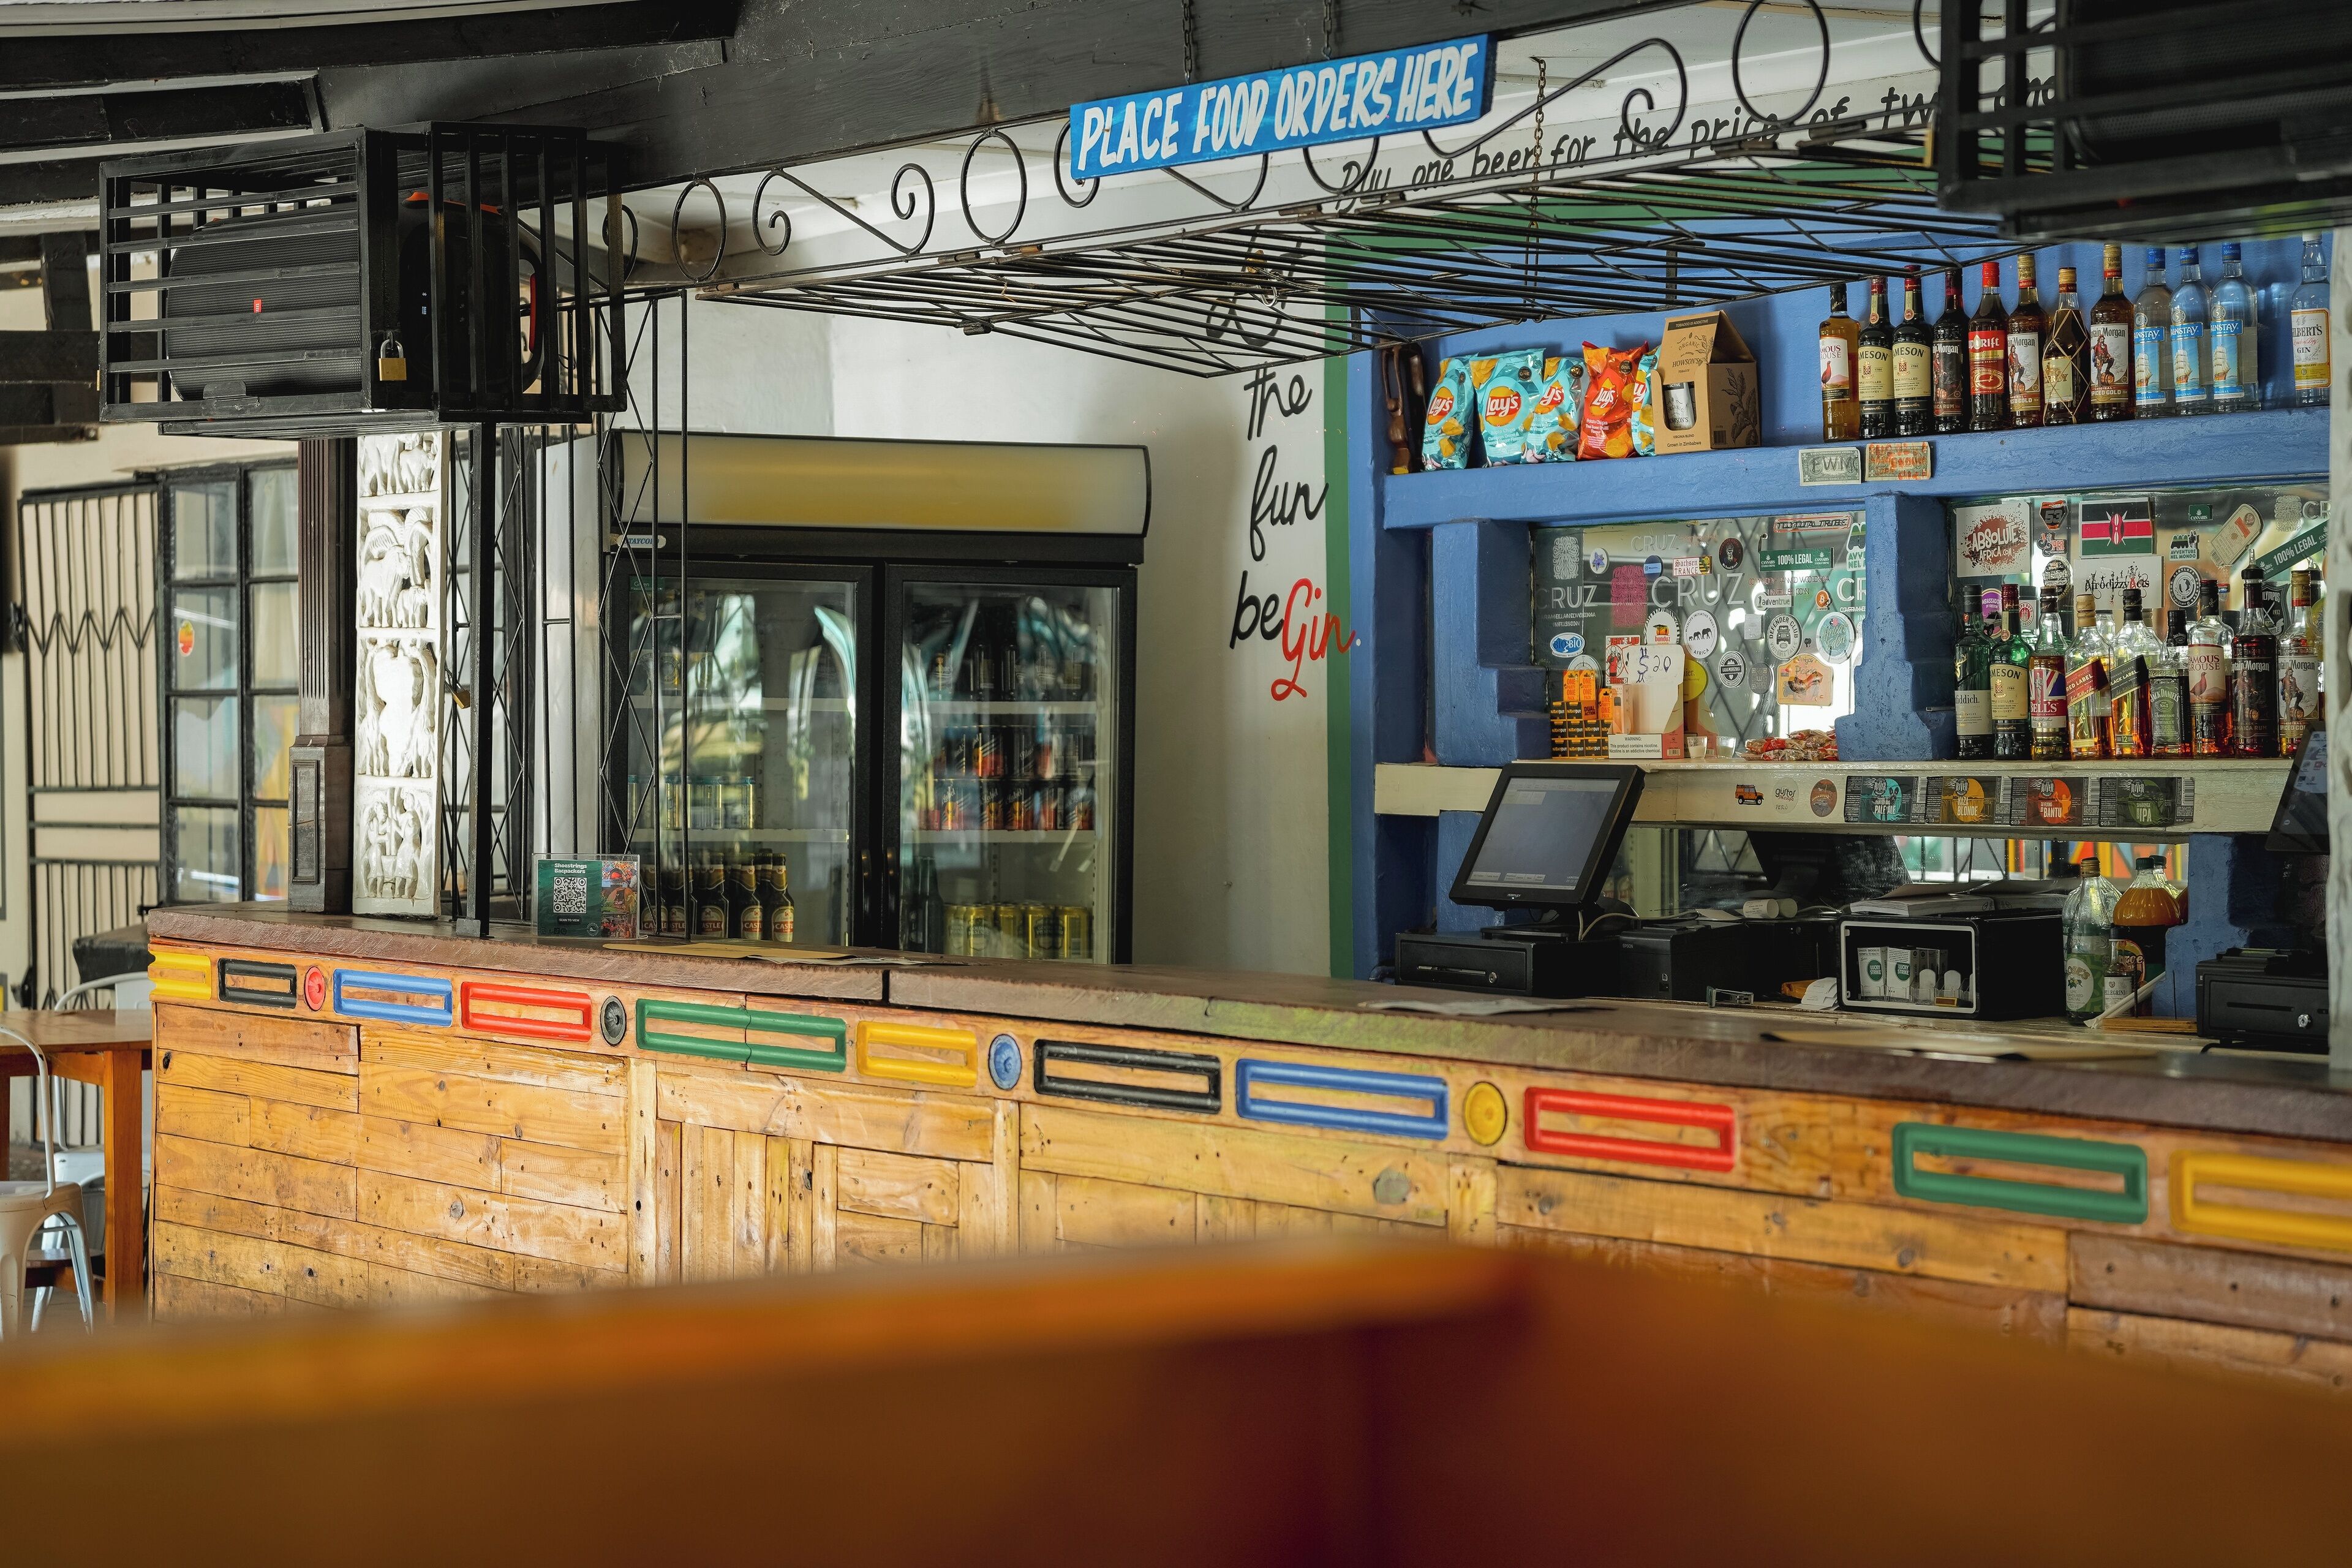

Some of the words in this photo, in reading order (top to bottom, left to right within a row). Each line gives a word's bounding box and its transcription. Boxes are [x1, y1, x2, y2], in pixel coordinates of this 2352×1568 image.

[1077, 88, 1183, 172] PLACE
[1193, 78, 1270, 154] FOOD
[1275, 58, 1396, 141] ORDERS
[1395, 43, 1479, 123] HERE
[1412, 159, 1455, 191] one
[1471, 145, 1533, 183] beer
[1550, 134, 1597, 179] for
[1613, 118, 1670, 162] the
[1881, 87, 1941, 131] tw
[2102, 327, 2126, 338] Morgan
[2171, 325, 2198, 335] AINSTAY
[2211, 323, 2239, 332] AINSTAY
[2293, 324, 2323, 337] ILBERT'S
[1678, 341, 1700, 350] ORGANIC
[2013, 337, 2035, 347] Morgan
[1893, 347, 1924, 358] AMESON
[1937, 344, 1959, 354] Morgan
[1859, 351, 1888, 361] AMESON
[1672, 358, 1700, 368] HOWSON'S
[1244, 360, 1312, 441] the
[1539, 385, 1562, 405] y's
[1593, 388, 1615, 409] Lay's
[1429, 396, 1453, 417] Lay's
[1486, 394, 1519, 417] Lay's
[1250, 445, 1329, 562] fun
[2045, 509, 2064, 524] 53
[1972, 522, 2019, 551] ABSOLUTE
[2274, 546, 2295, 566] 100%
[2294, 535, 2318, 554] LEGAL
[1675, 559, 1698, 569] Sachsen
[1777, 554, 1794, 565] 100%
[1795, 553, 1813, 564] LEGAL
[1652, 573, 1746, 608] CRUZ
[1685, 617, 1694, 633] WILDLIFE
[1769, 616, 1790, 639] DEFENDER
[1790, 619, 1798, 639] CLUB
[2188, 655, 2220, 663] FAMOUS
[2244, 660, 2269, 672] Morgan
[2290, 660, 2315, 671] Morgan
[2066, 684, 2075, 692] RED
[2075, 674, 2093, 686] LABEL
[2111, 677, 2122, 685] LACK
[2122, 669, 2138, 679] LABEL
[2150, 690, 2160, 703] JACK
[2160, 688, 2180, 703] DANIEL'S
[2030, 702, 2057, 713] BELL'S
[1874, 782, 1887, 791] RIVER
[1956, 782, 1968, 791] RIVER
[2041, 783, 2054, 793] RIVER
[2131, 783, 2144, 793] RIVER
[1874, 805, 1887, 814] PALE
[1887, 805, 1896, 814] ALE
[1957, 805, 1978, 816] BLONDE
[2043, 807, 2062, 818] BANTU
[2139, 808, 2152, 822] IPA
